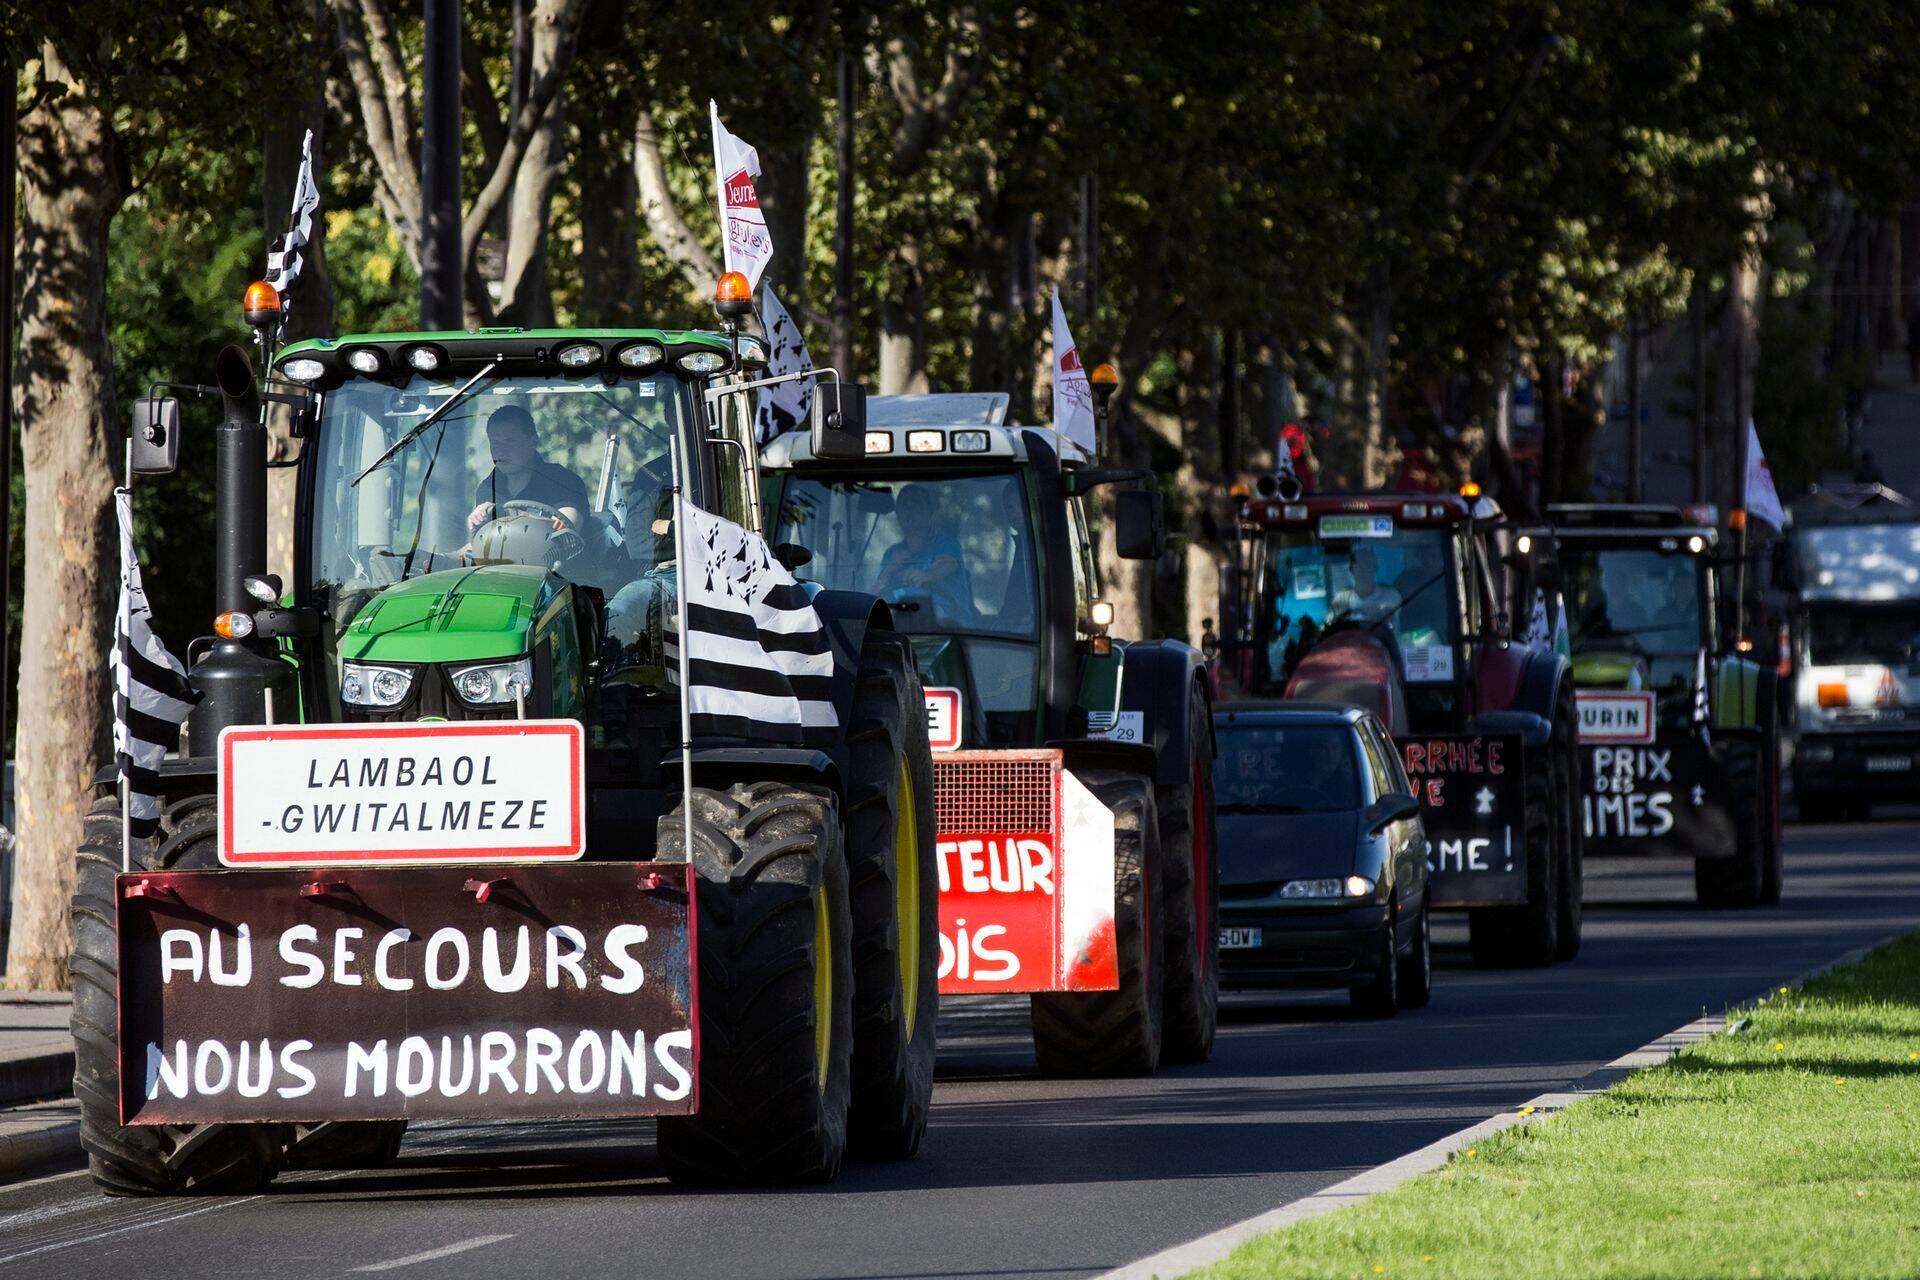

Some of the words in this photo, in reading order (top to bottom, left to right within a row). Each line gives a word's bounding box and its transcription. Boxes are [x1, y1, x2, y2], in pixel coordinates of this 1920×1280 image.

[1117, 728, 1135, 740] 29
[1577, 708, 1639, 727] URIN
[307, 755, 498, 788] LAMBAOL
[1594, 748, 1672, 782] PRIX
[263, 800, 547, 834] -GWITALMEZE
[936, 838, 1054, 895] TEUR
[160, 922, 252, 987] AU
[278, 923, 649, 994] SECOURS
[146, 1037, 317, 1101] NOUS
[343, 1027, 693, 1101] MOURRONS
